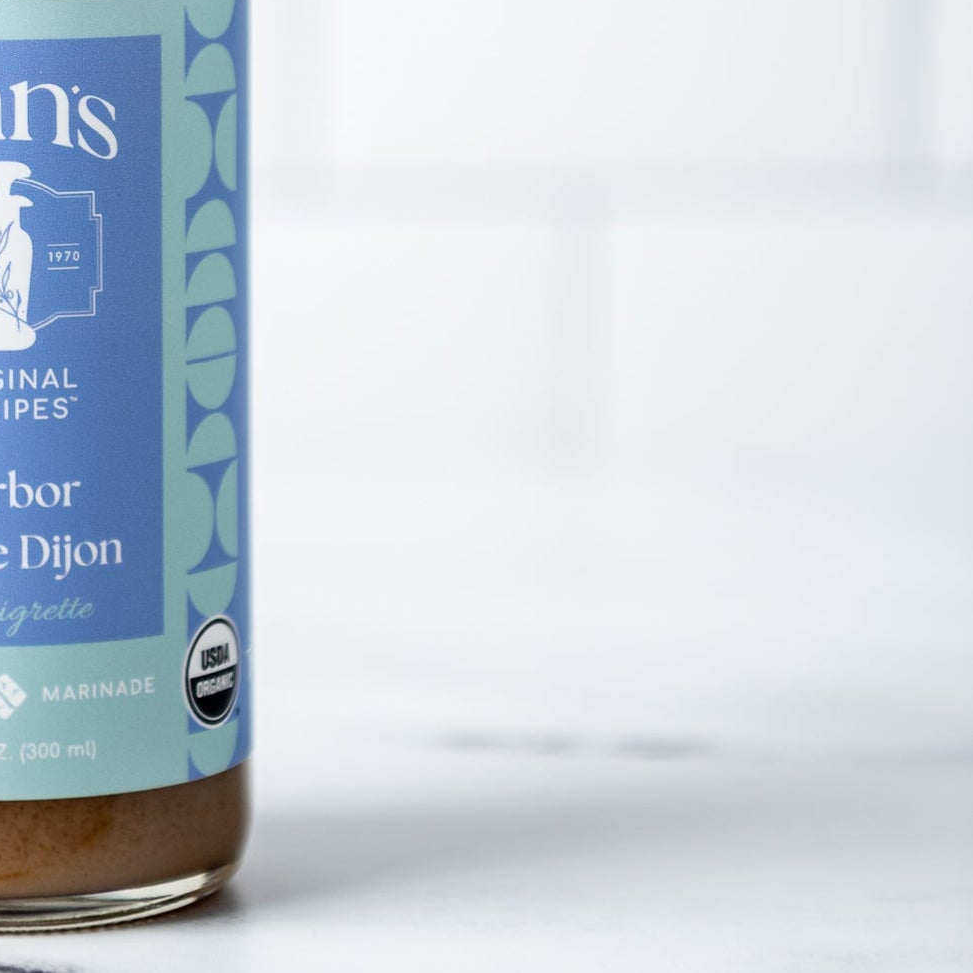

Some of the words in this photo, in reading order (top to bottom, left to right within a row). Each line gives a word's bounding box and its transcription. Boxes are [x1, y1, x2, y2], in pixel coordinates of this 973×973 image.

[47, 250, 81, 263] 1970
[20, 534, 123, 581] Dijon
[200, 643, 231, 671] USDA
[42, 676, 156, 702] MARINADE
[196, 672, 234, 699] ORGANIC
[20, 741, 61, 764] (300
[68, 740, 97, 760] ml)
